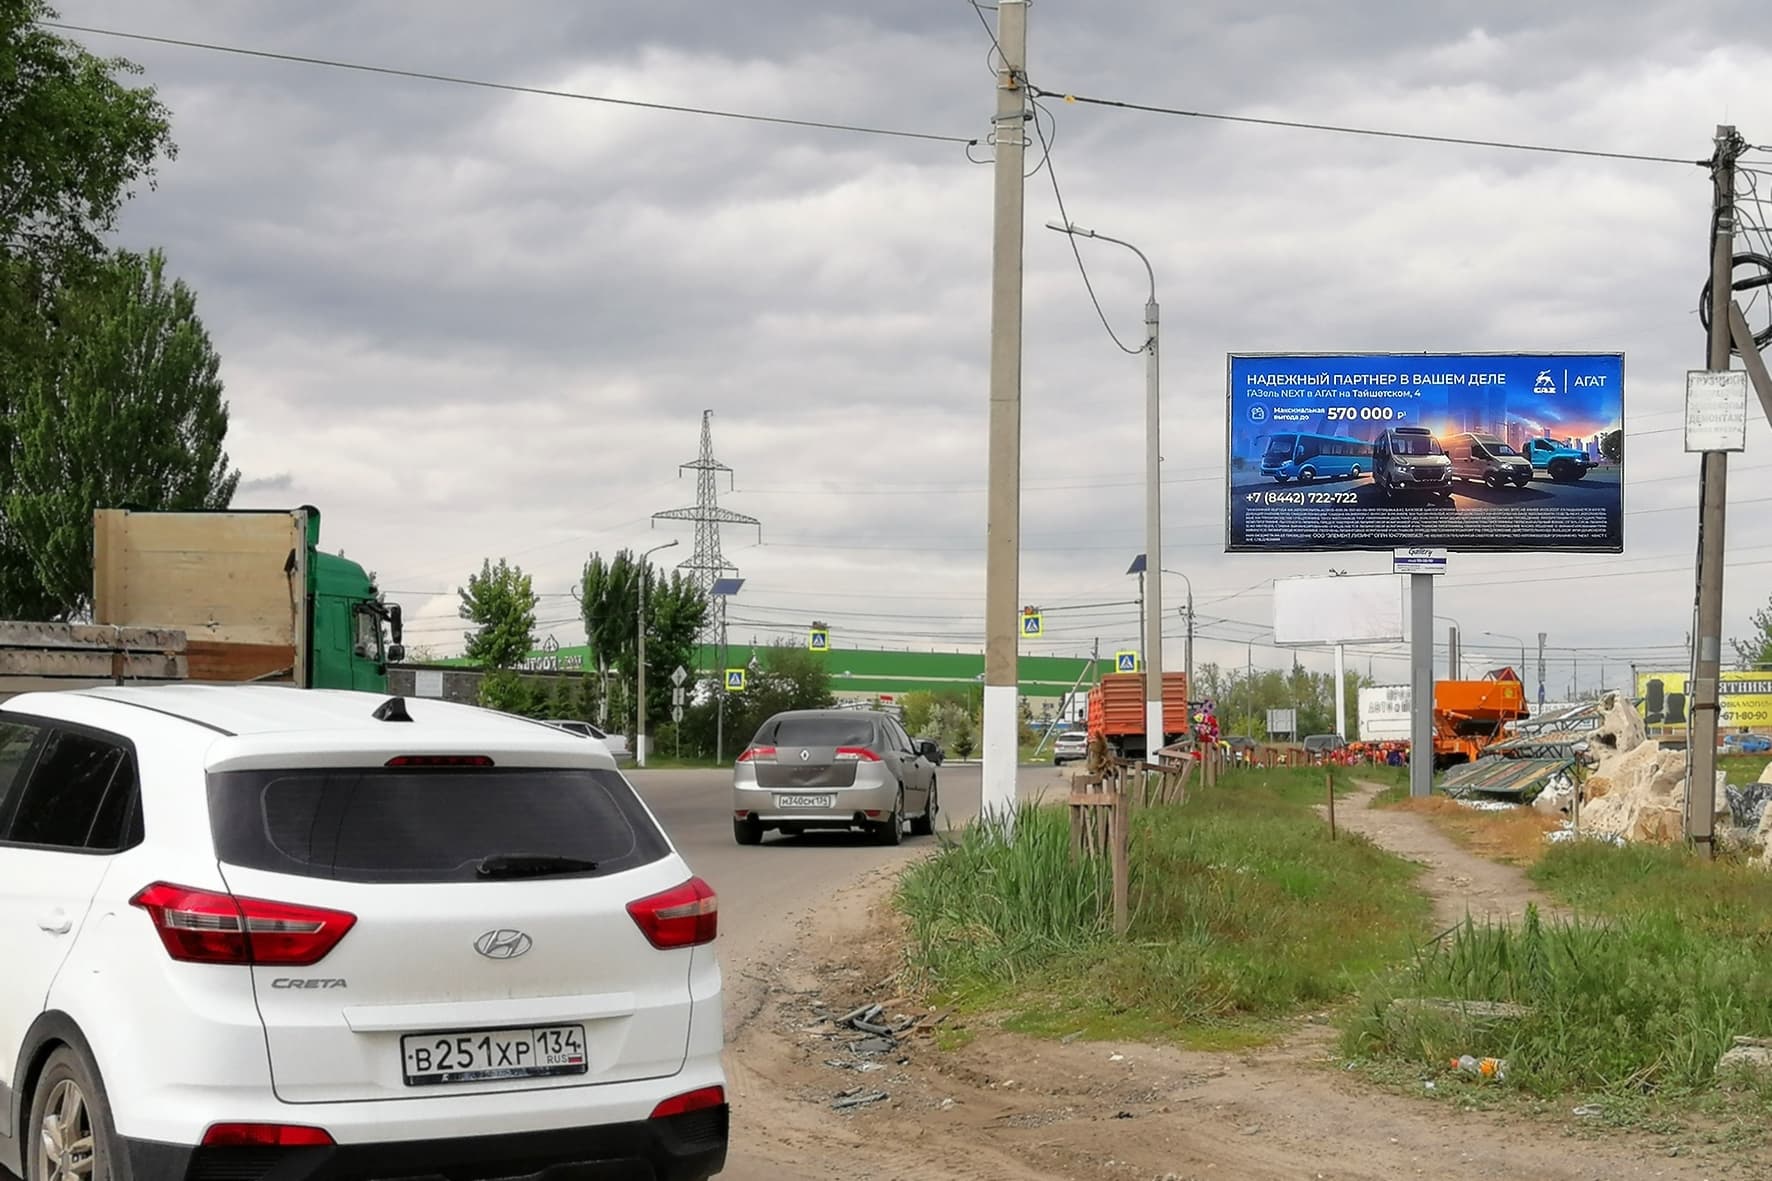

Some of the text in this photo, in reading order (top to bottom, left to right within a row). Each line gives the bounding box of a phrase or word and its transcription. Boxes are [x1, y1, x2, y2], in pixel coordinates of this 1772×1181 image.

[1247, 372, 1506, 386] НАДЕЖНЫЙ ПАРТНЕР В ВАШЕМ ДЕЛЕ
[1574, 375, 1607, 387] АГАТ
[1247, 389, 1280, 398] ГАЗель
[1281, 389, 1306, 398] NEXT
[1314, 389, 1337, 398] АГАТ
[1339, 390, 1350, 398] на
[1352, 388, 1413, 399] Тайшетском,
[1414, 389, 1421, 398] 4
[1327, 407, 1357, 420] 570
[1360, 407, 1393, 420] 000
[1246, 492, 1358, 505] +7 (8442) 722-722
[271, 977, 348, 989] CRETA
[415, 1030, 578, 1072] В251ХР 134
[547, 1054, 567, 1064] RUS
